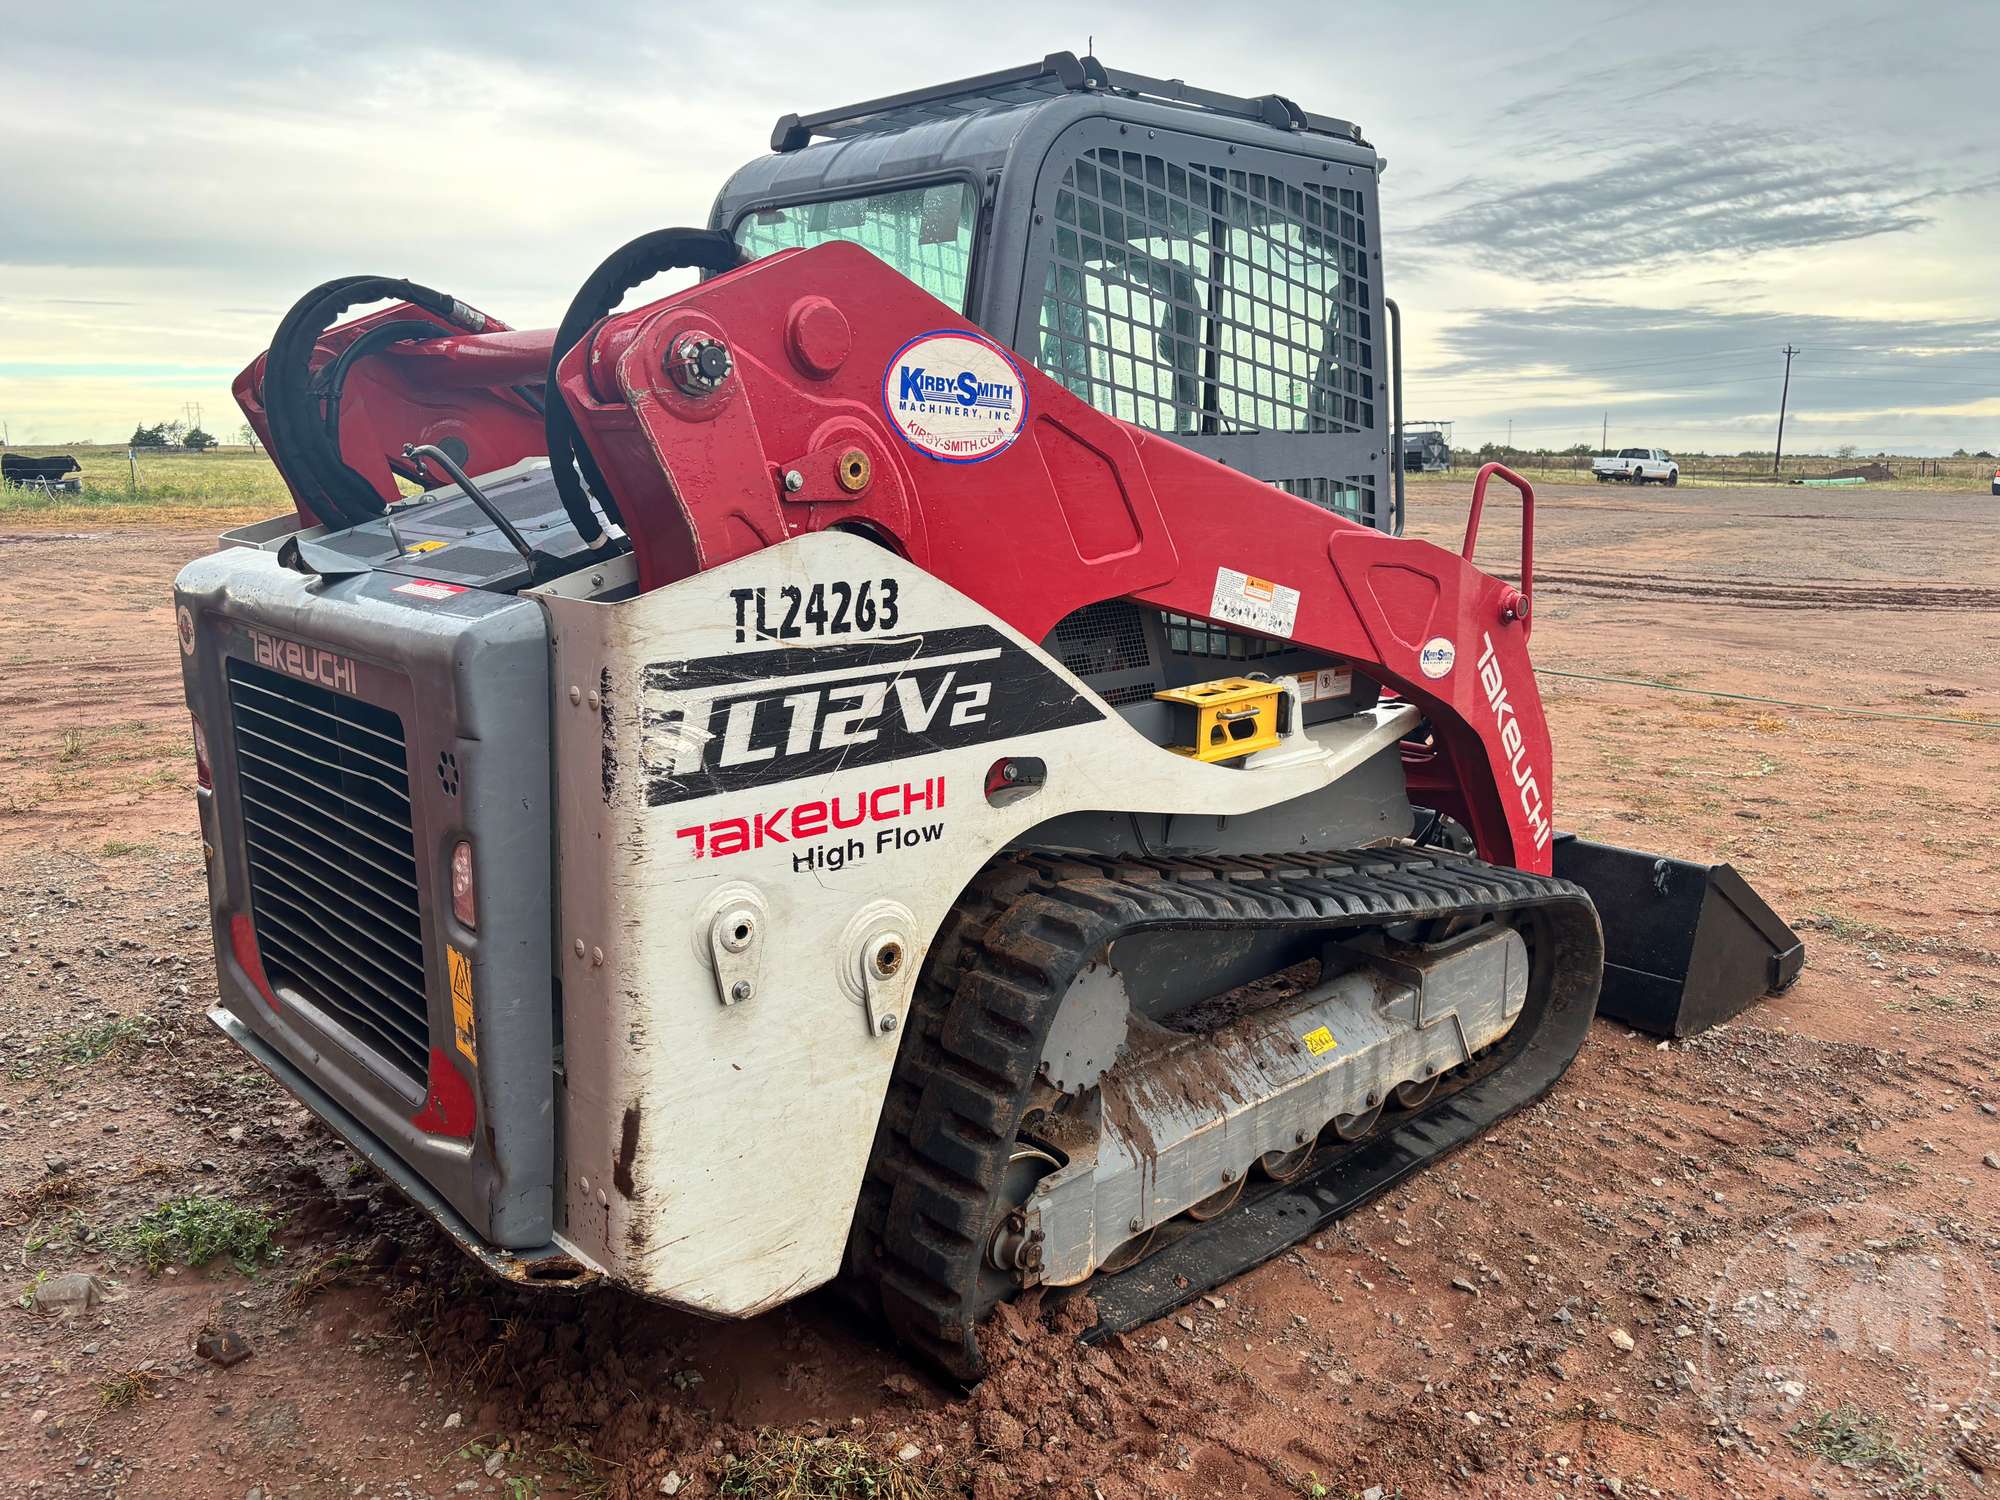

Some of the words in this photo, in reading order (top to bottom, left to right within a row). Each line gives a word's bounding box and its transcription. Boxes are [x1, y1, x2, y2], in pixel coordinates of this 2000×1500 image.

[898, 401, 982, 420] MACHINERY,
[730, 578, 899, 643] TL24263
[792, 836, 865, 874] High
[876, 822, 945, 855] Flow
